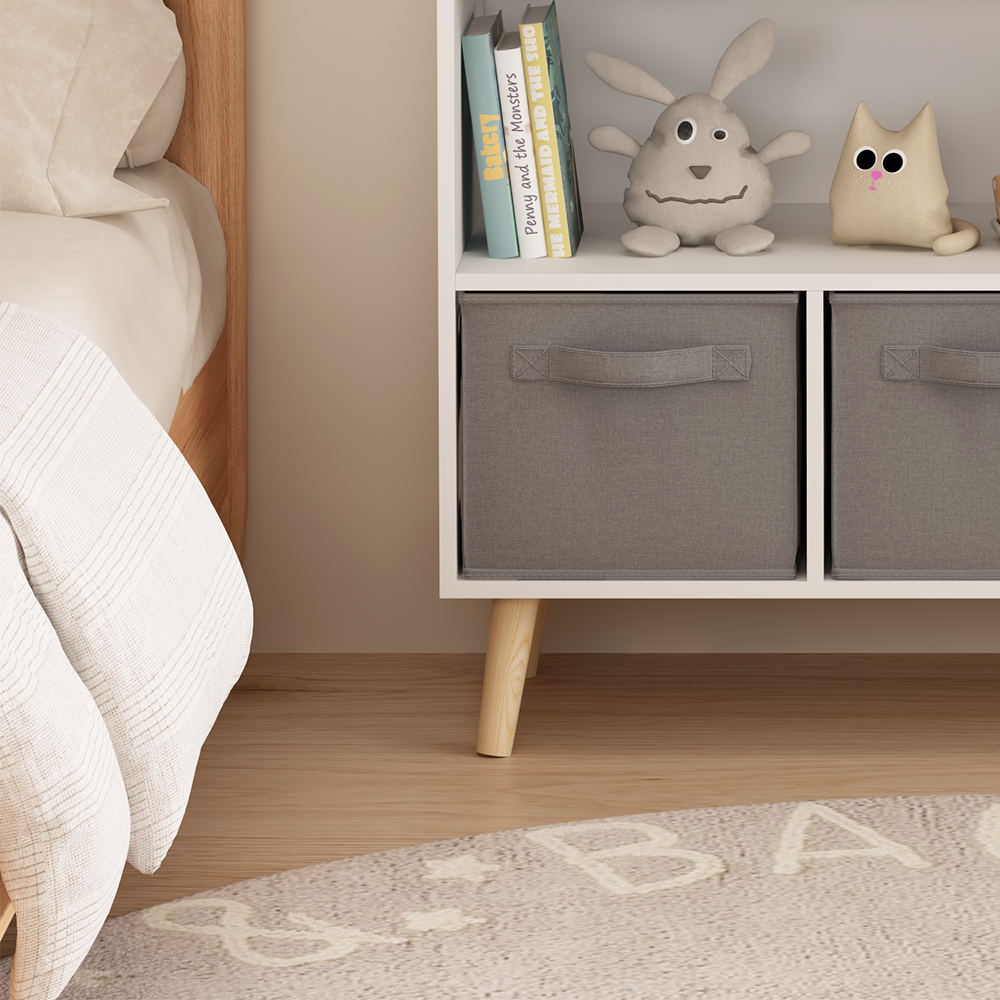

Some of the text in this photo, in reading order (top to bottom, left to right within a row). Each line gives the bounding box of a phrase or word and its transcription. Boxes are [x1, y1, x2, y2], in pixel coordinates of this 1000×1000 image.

[527, 65, 545, 102] THE
[479, 113, 505, 181] Bakery
[505, 72, 538, 236] Penny and the Monsters
[533, 105, 551, 142] AND
[538, 144, 562, 230] MERMAID
